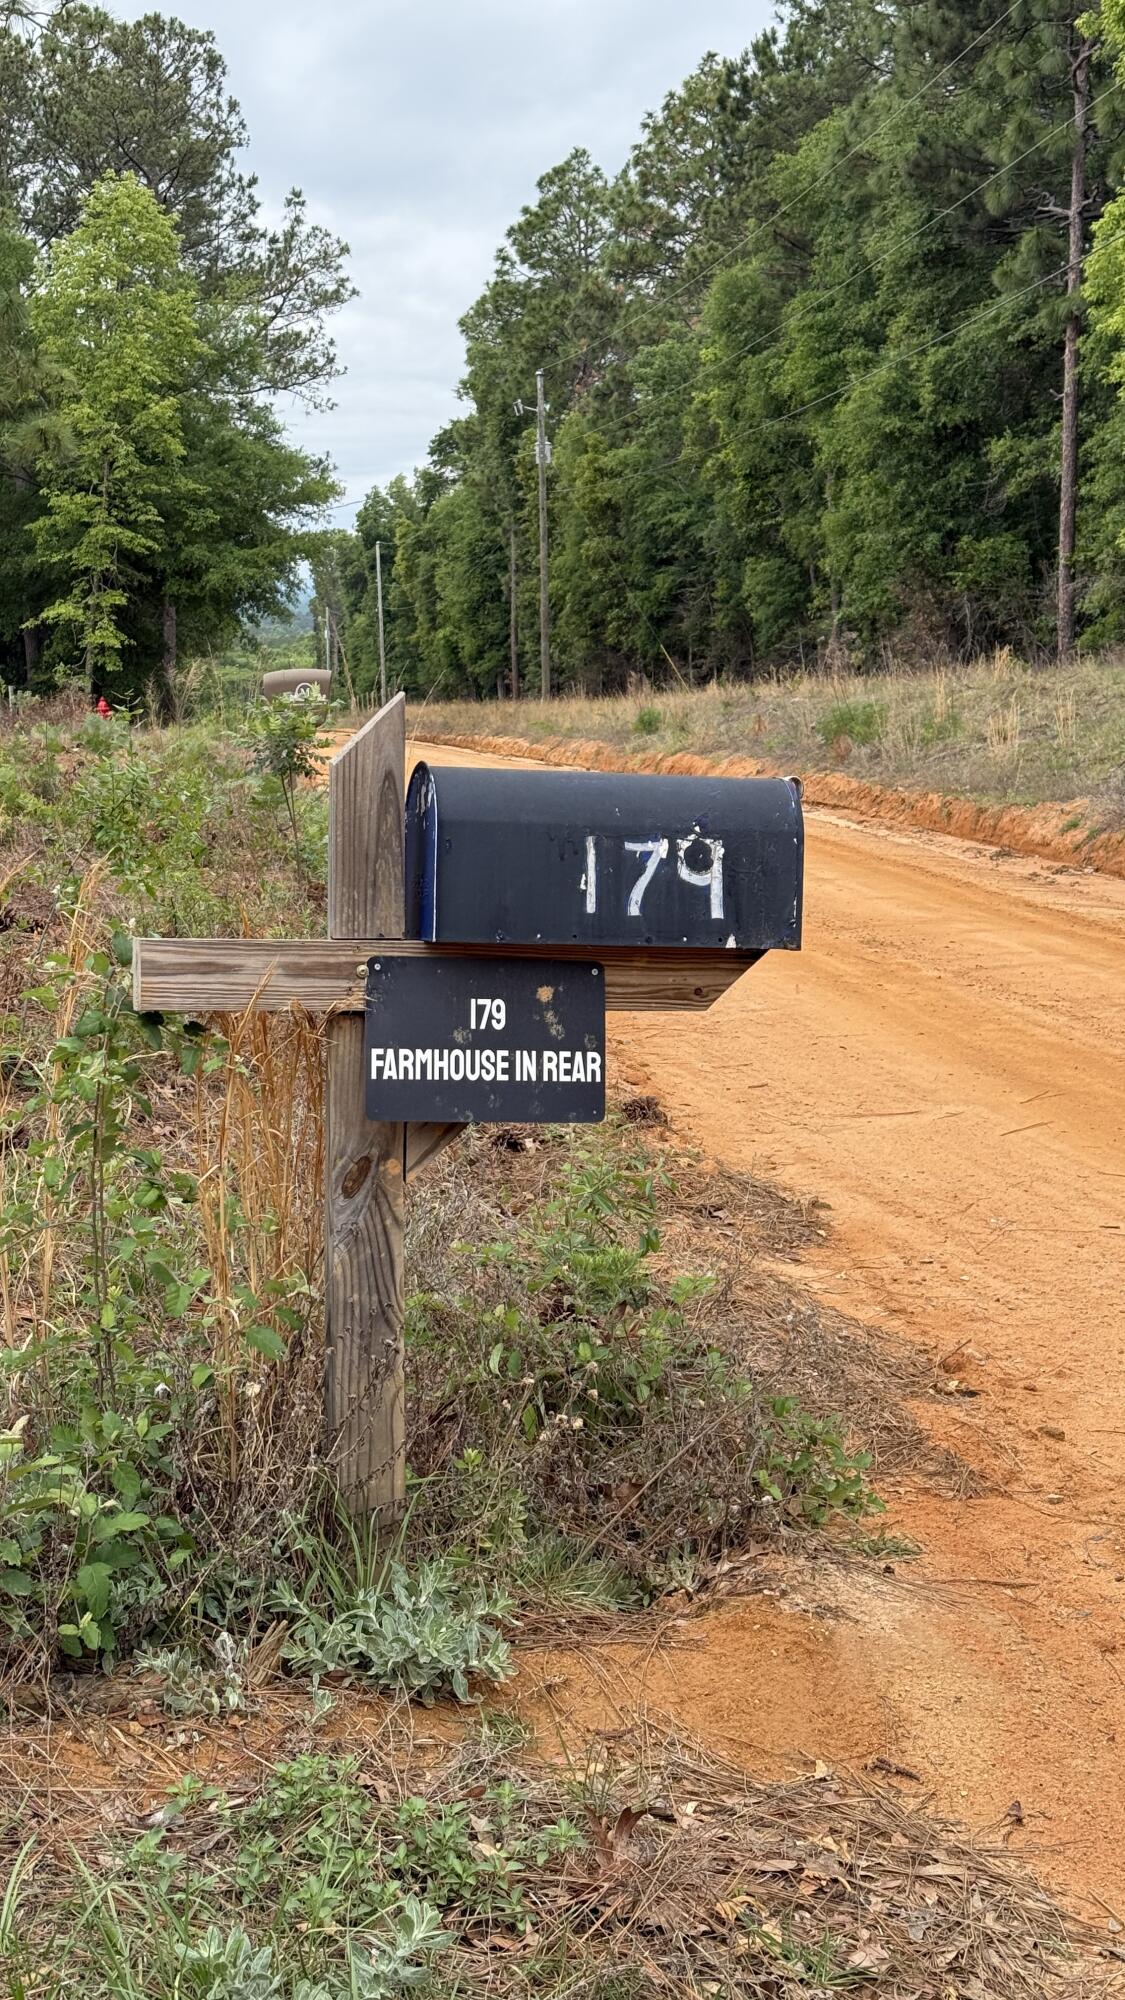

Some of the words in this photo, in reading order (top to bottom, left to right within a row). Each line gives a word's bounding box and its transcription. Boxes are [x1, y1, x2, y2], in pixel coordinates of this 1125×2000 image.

[583, 834, 726, 920] 179
[470, 998, 506, 1031] 179
[370, 1047, 509, 1082] FARMHOUSE
[515, 1049, 537, 1082] IN
[542, 1050, 602, 1083] REAR
